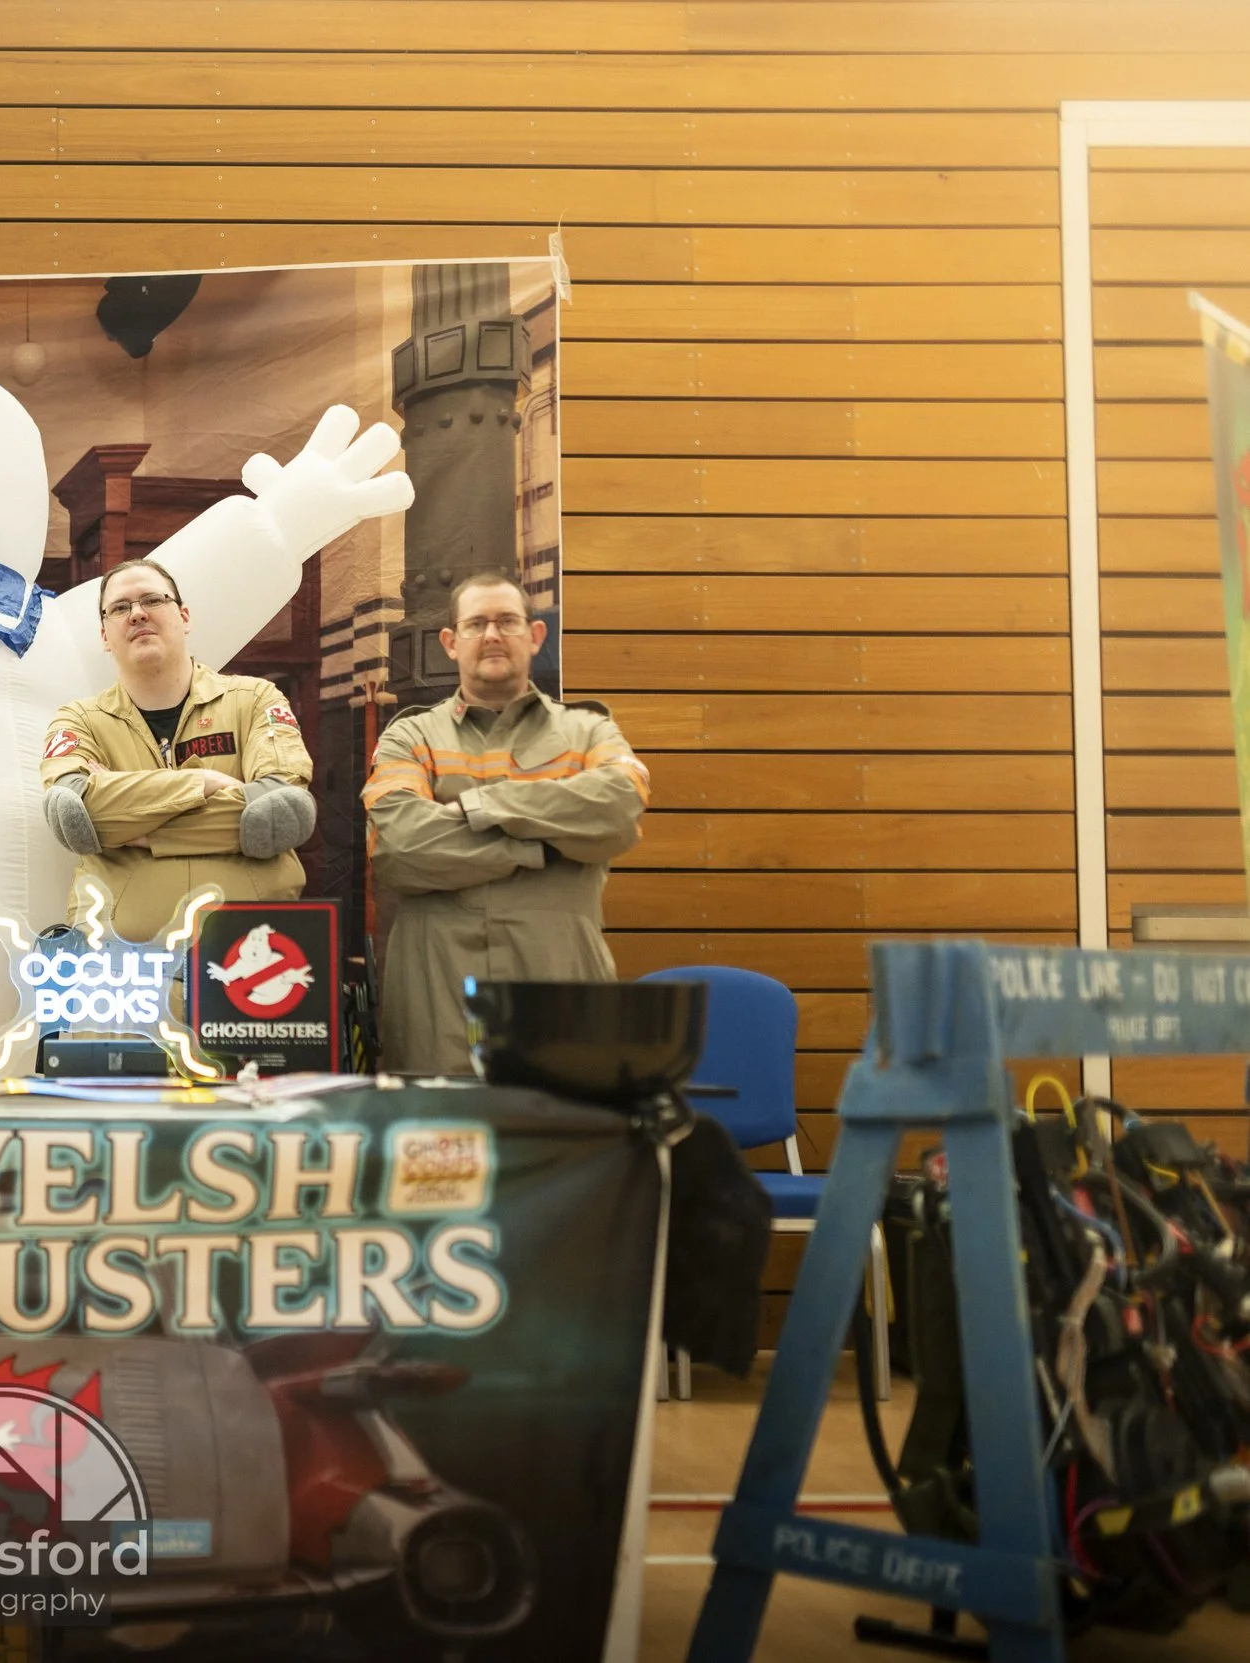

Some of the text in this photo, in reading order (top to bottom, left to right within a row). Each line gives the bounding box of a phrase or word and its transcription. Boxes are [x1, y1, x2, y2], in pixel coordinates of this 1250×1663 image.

[176, 734, 233, 762] LAMBERT
[19, 951, 175, 988] OCCULT
[988, 955, 1064, 1000] POLICE
[1152, 961, 1180, 1003] DO
[35, 988, 160, 1024] BOOKS
[200, 1021, 328, 1039] GHOSTBUSTERS
[774, 1523, 871, 1575] POLICE
